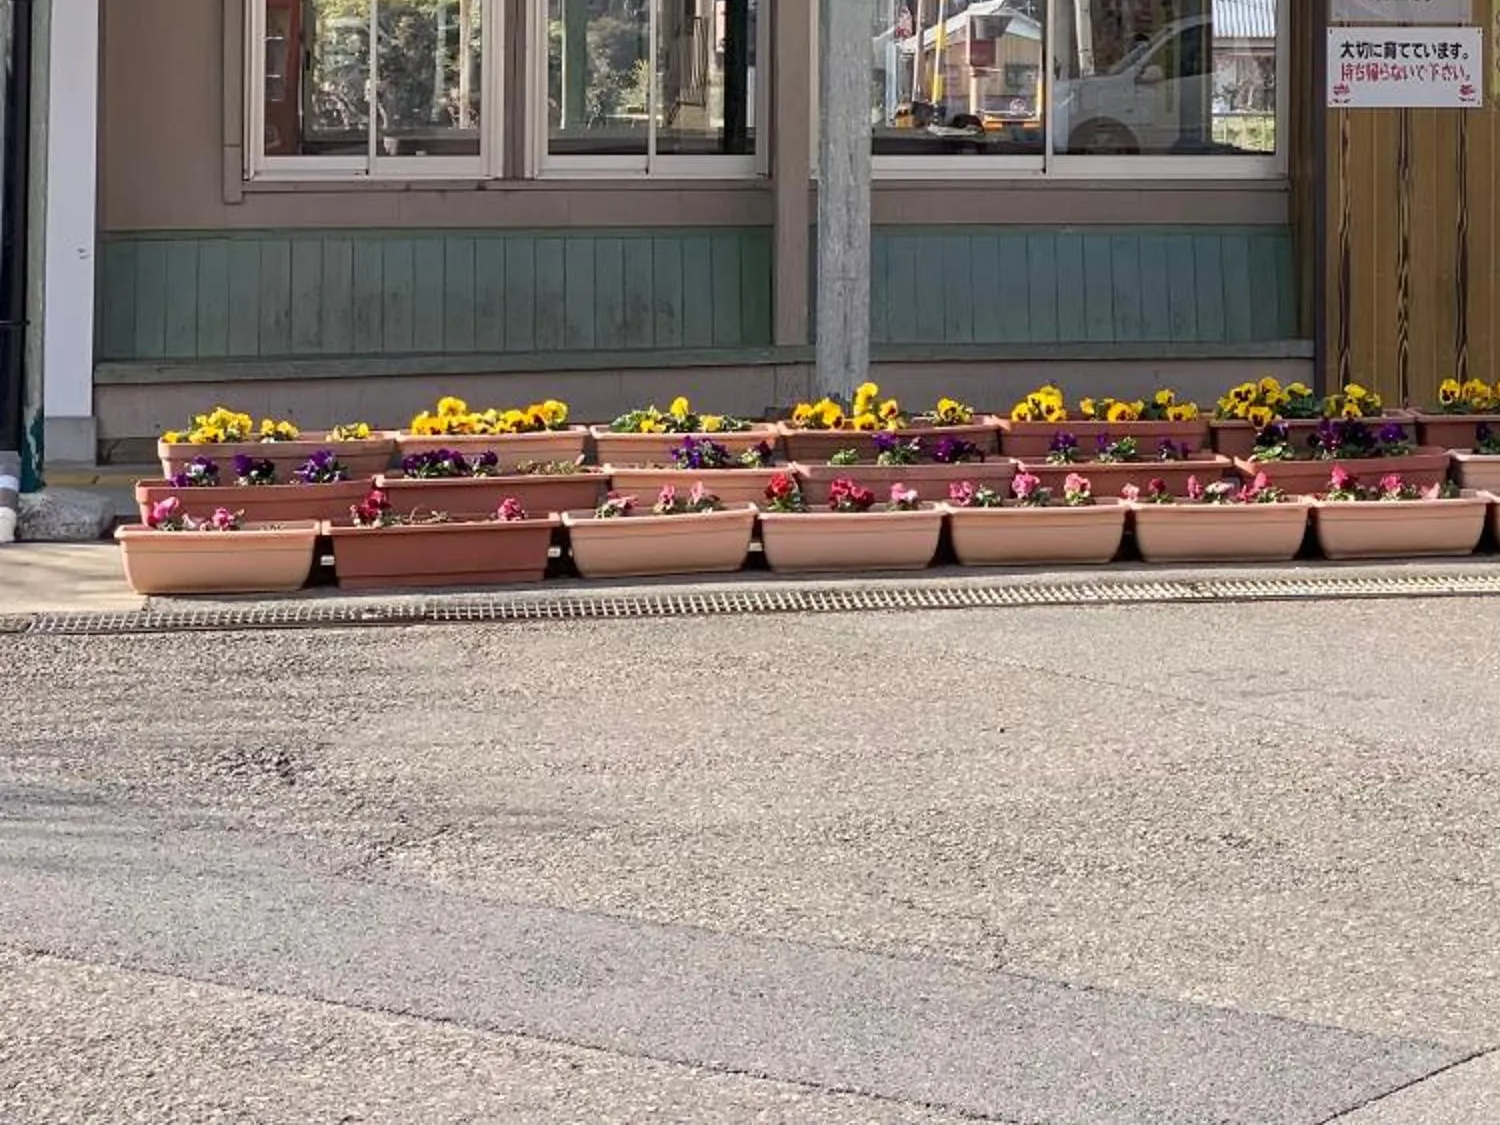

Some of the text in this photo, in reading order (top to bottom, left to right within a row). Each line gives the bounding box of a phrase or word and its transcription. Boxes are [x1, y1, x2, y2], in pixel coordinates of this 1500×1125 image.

[1340, 41, 1469, 60] 大切に育てています。
